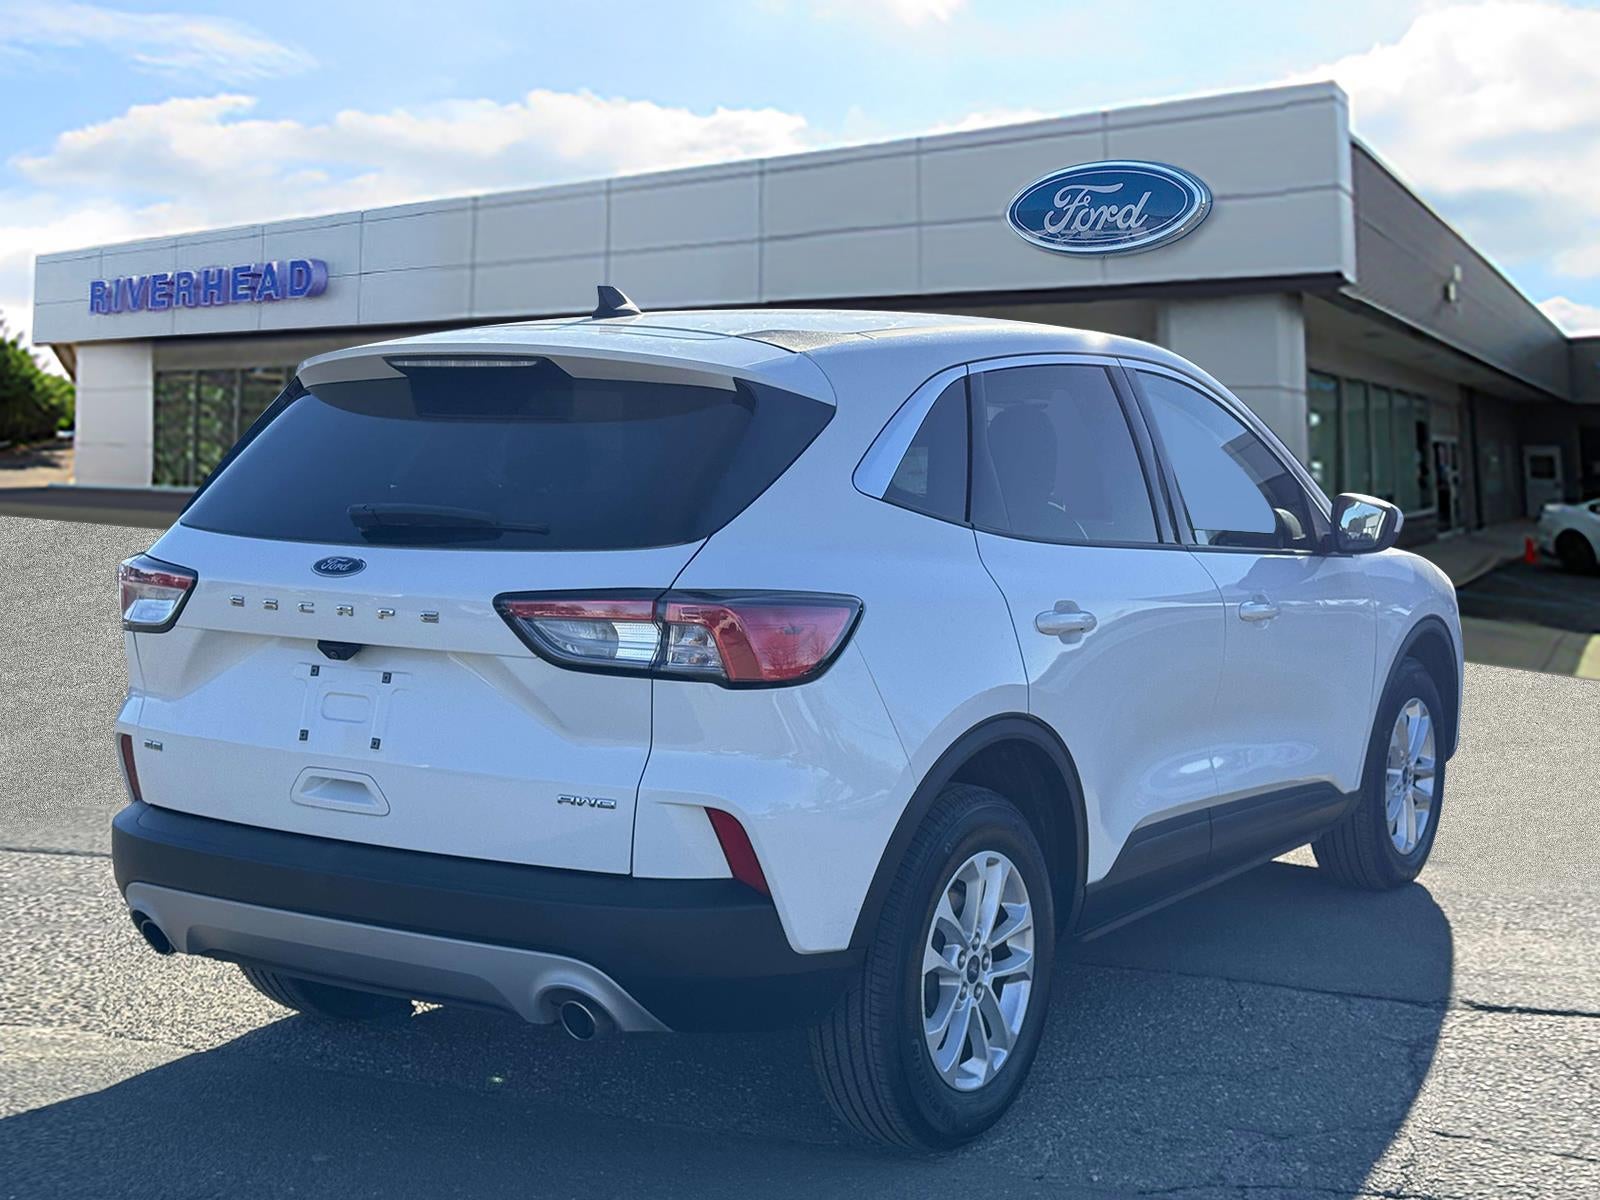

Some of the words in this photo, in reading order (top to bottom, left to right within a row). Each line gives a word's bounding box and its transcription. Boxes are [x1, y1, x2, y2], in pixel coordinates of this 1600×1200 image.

[1043, 182, 1152, 234] Ford
[89, 258, 327, 315] RIVERHEAD
[320, 558, 353, 571] Ford
[229, 594, 440, 624] ESCAPE
[556, 794, 617, 810] AWD
